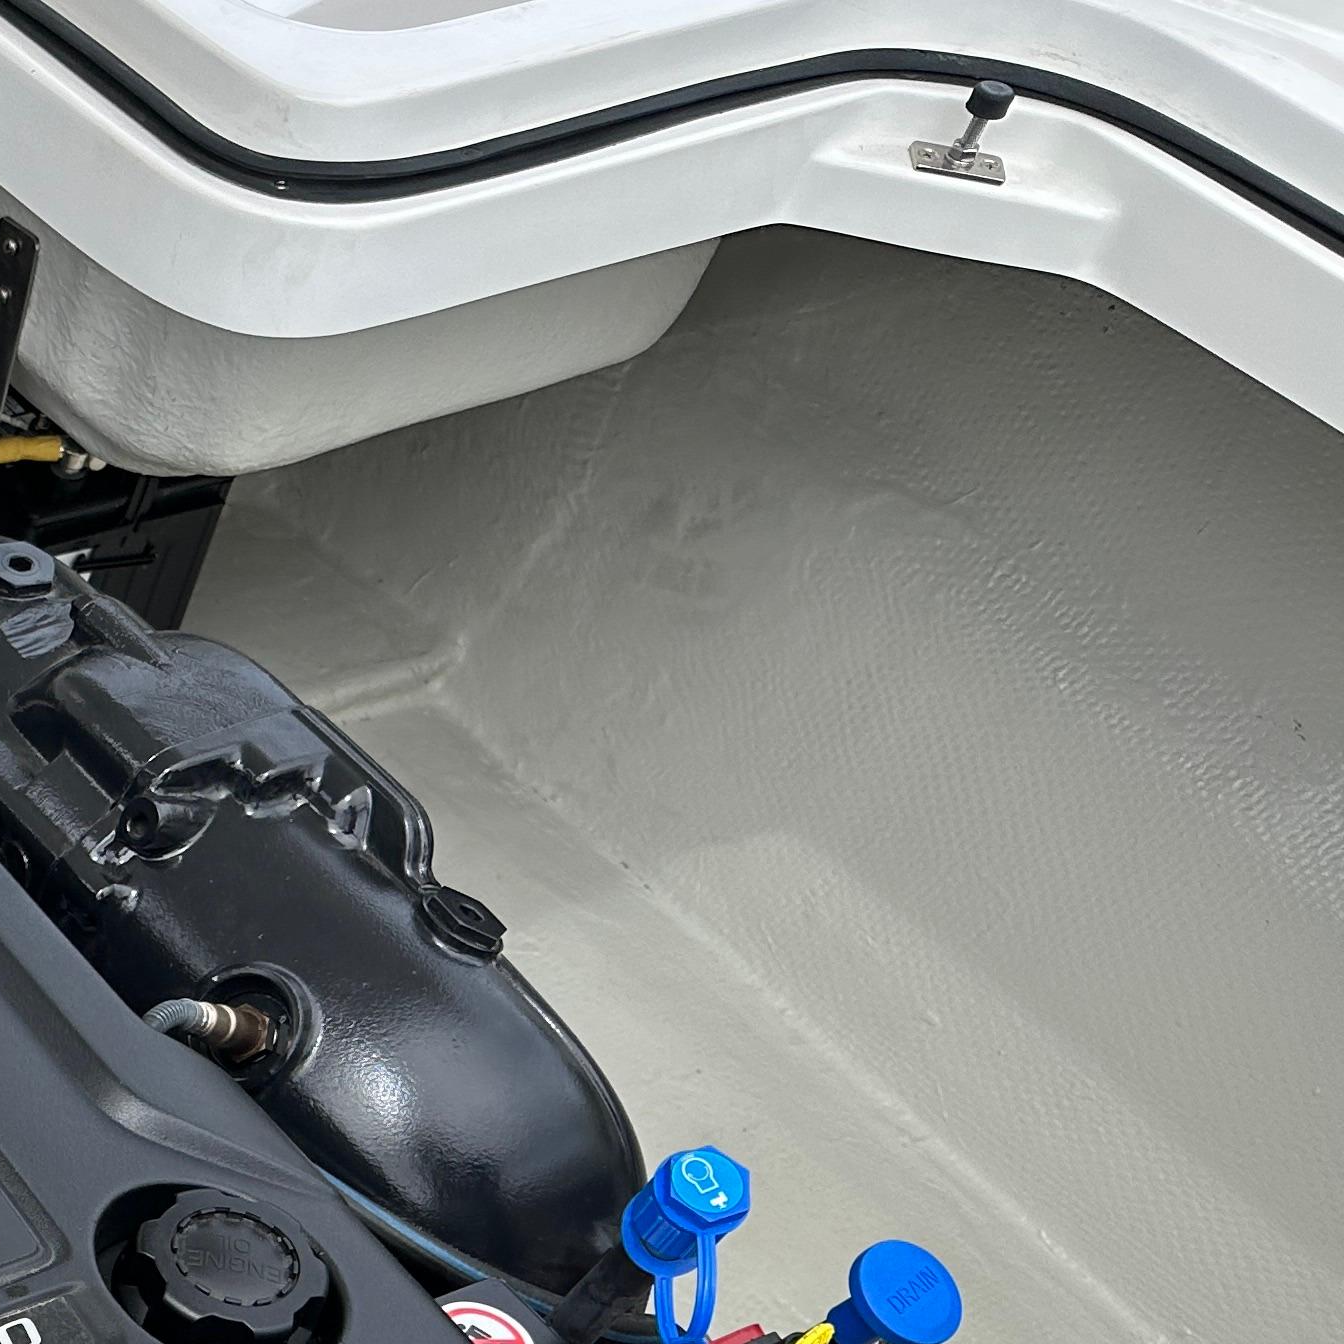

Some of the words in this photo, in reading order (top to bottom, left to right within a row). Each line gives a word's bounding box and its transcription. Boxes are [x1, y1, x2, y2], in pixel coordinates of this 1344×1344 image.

[215, 1234, 250, 1254] OIL
[186, 1248, 282, 1285] ENGINE
[885, 1265, 941, 1315] DRAIN
